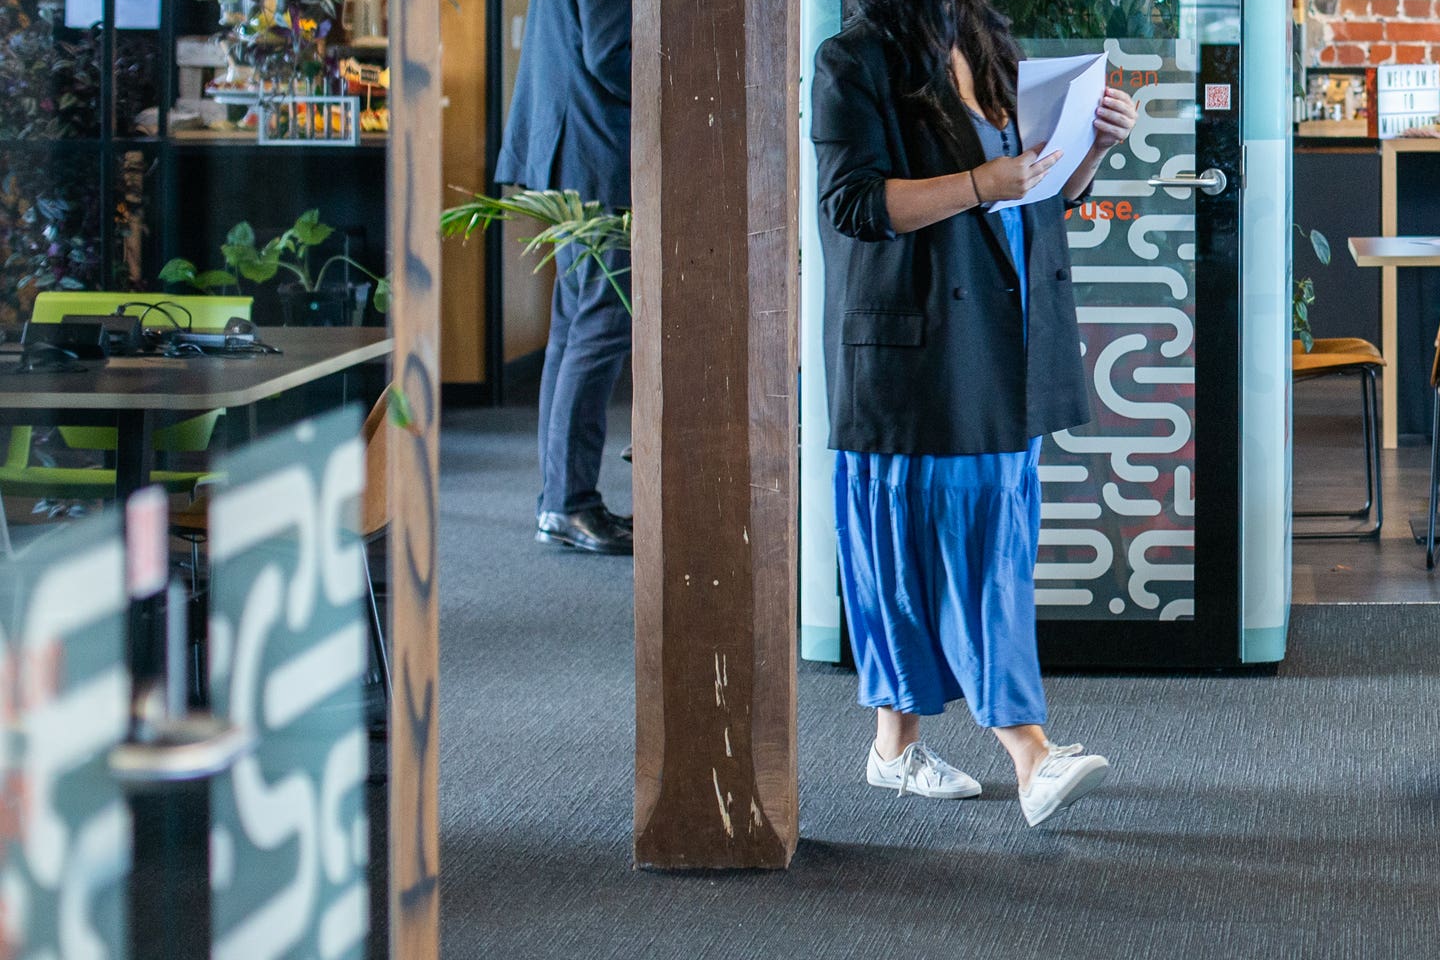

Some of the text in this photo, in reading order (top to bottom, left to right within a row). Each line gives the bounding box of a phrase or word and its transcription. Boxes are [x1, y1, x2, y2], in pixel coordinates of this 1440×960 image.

[1105, 66, 1160, 88] d an
[1387, 69, 1437, 87] WELCOME
[1403, 92, 1415, 110] TO
[1080, 199, 1141, 221] use.
